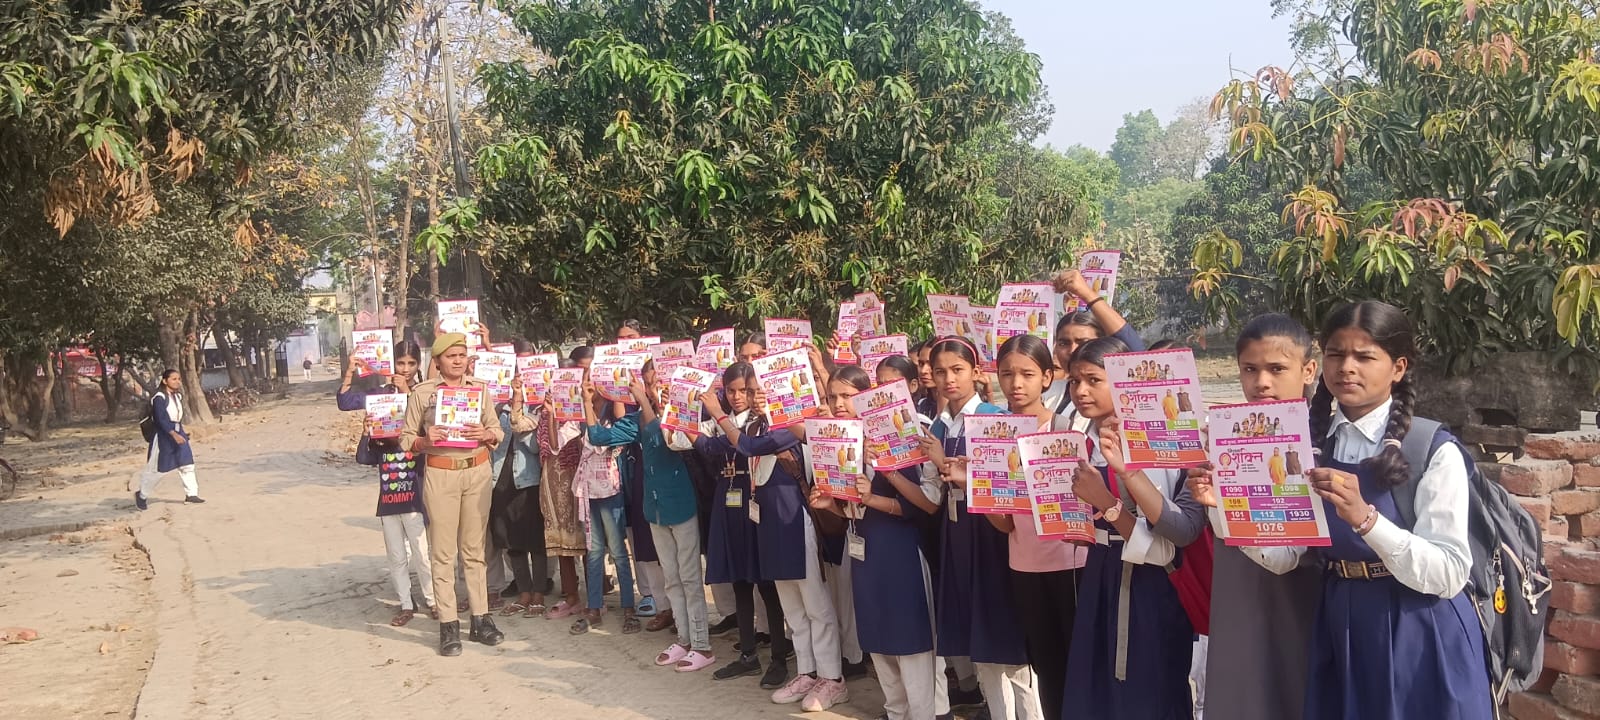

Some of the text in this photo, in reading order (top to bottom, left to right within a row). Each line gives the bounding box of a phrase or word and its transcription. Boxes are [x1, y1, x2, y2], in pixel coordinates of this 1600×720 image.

[1231, 448, 1263, 469] शक्ति
[382, 491, 415, 504] MOMMY
[1256, 523, 1285, 532] 1076
